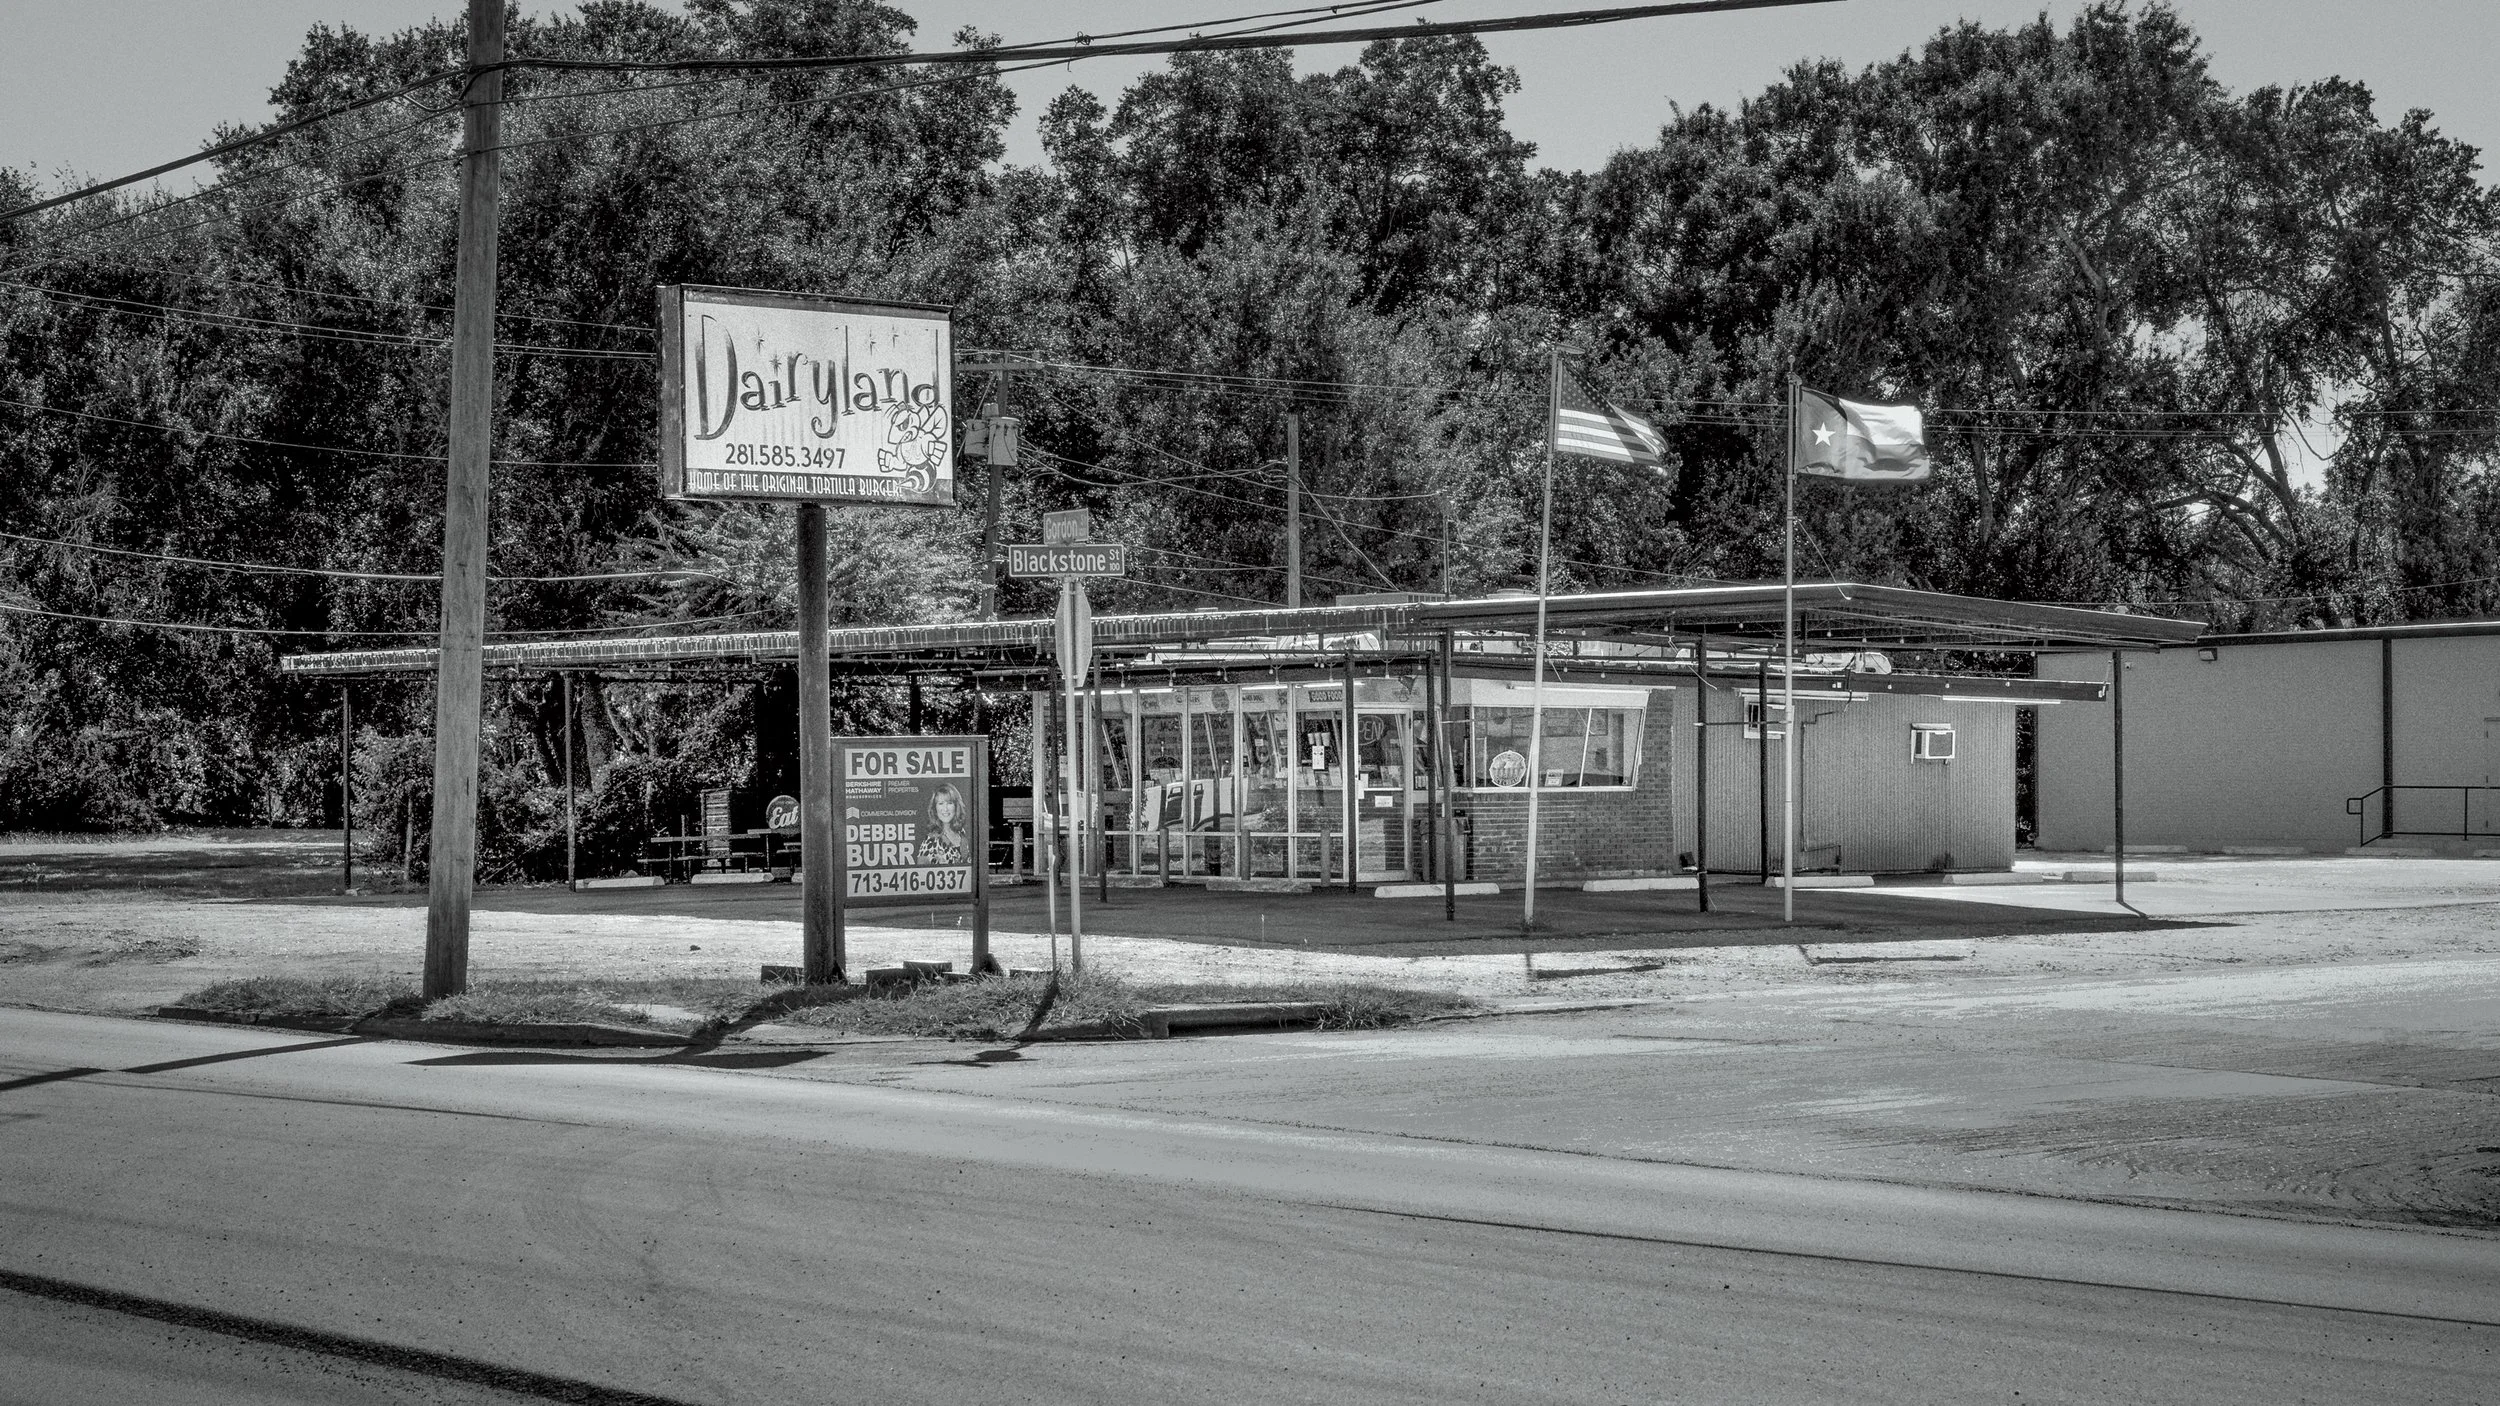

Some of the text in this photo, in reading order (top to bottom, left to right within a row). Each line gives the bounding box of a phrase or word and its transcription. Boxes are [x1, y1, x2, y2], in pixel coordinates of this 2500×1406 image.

[690, 314, 945, 440] Dairyland
[725, 443, 846, 470] 281.585.3497
[687, 471, 720, 491] HOME
[723, 472, 737, 491] OF
[739, 473, 759, 491] THE
[762, 474, 810, 494] ORIGINAL
[812, 476, 856, 496] TORTILLA
[1045, 516, 1078, 541] Gordon
[1013, 549, 1120, 573] Blackstone St
[1109, 563, 1120, 571] 100
[1358, 720, 1381, 741] PEN
[851, 750, 965, 776] FOR SALE
[768, 805, 799, 830] Eat
[846, 823, 916, 843] DEBBIE
[846, 843, 916, 868] BURR
[851, 869, 967, 894] 713-416-0337
